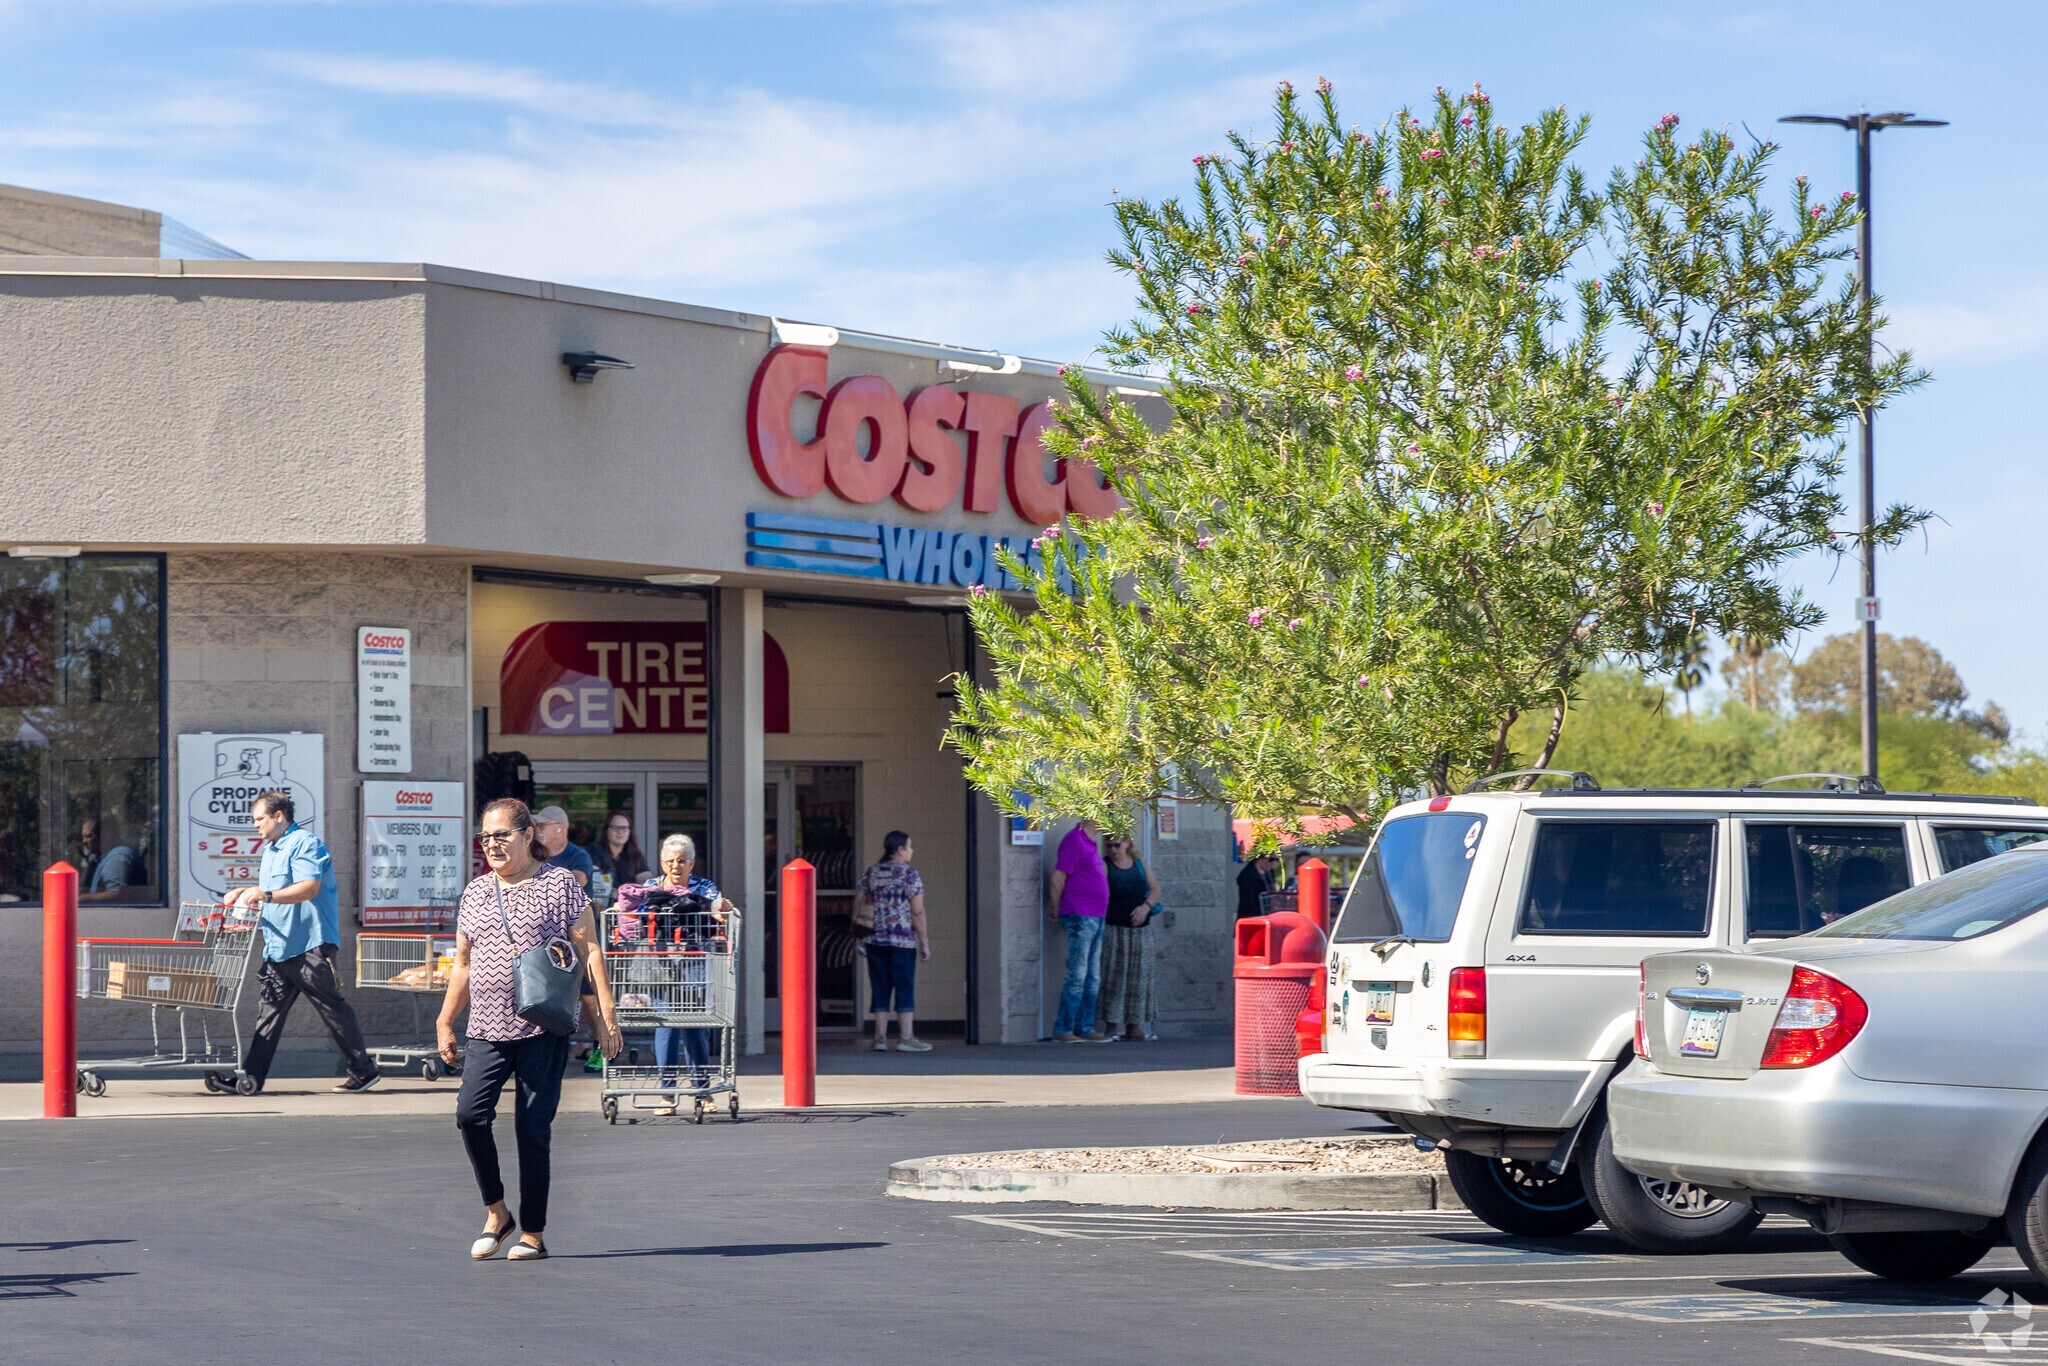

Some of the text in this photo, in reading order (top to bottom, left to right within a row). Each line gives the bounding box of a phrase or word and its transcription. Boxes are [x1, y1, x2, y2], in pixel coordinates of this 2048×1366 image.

[879, 525, 1110, 596] WHOLE
[364, 632, 405, 649] COSTCO
[587, 641, 705, 683] TIRE
[539, 686, 707, 729] CENTE
[396, 790, 433, 804] COSTCO
[386, 823, 443, 836] MEMBERS ONLY
[222, 837, 265, 855] 2.7
[371, 845, 388, 856] MON
[396, 845, 406, 856] FRI
[371, 866, 407, 879] SATURDAY
[371, 887, 399, 900] SUNDAY
